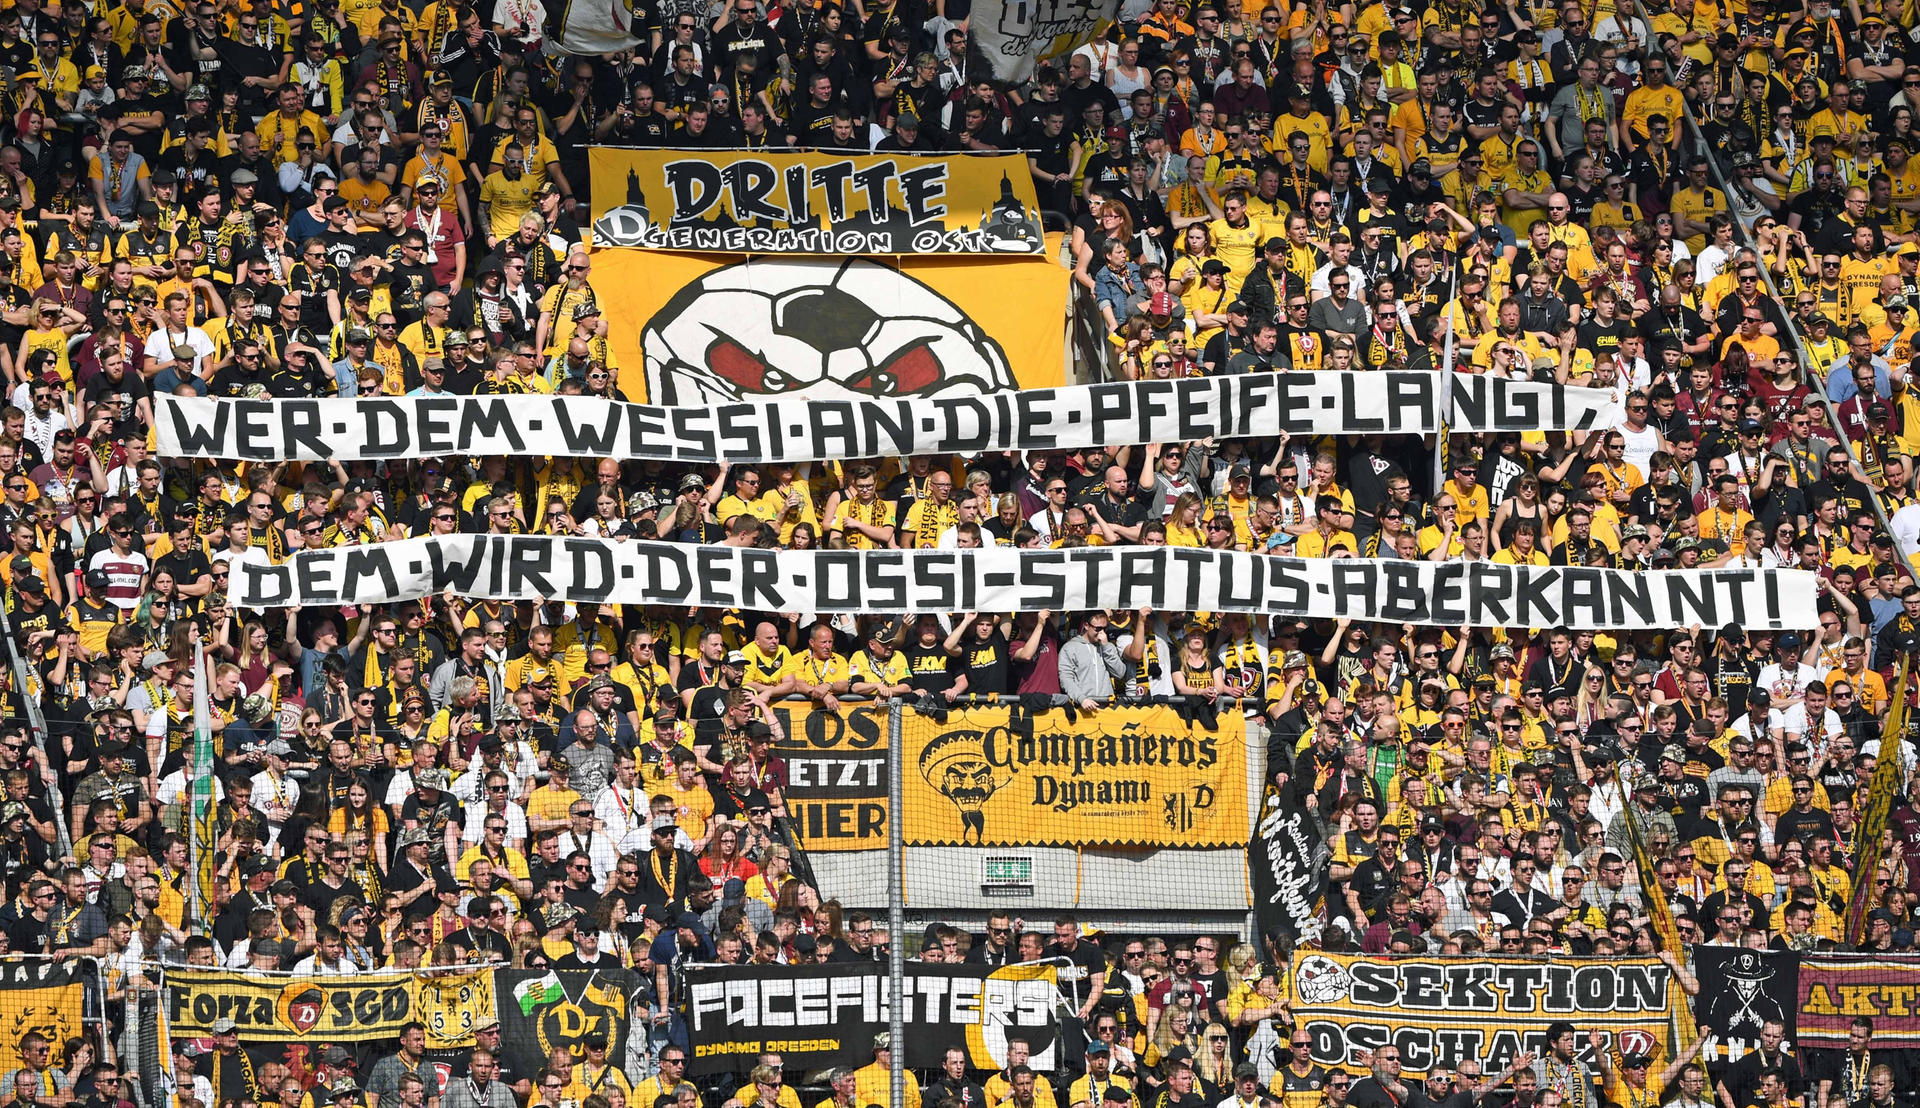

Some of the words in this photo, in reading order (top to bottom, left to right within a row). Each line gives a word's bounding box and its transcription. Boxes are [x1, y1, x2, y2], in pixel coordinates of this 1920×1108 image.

[664, 158, 949, 227] DRITTE
[642, 226, 892, 254] GENERATION
[167, 399, 334, 460] WER
[357, 399, 526, 456] DEM
[552, 399, 784, 463] WESSI
[808, 400, 914, 459] AN
[933, 389, 1058, 452] DIE
[1090, 372, 1315, 446] PFEIFE
[241, 547, 399, 605] DEM
[426, 535, 615, 601] WIRD
[638, 542, 786, 609] DER
[815, 548, 1309, 615] OSSI-STATUS
[1332, 558, 1783, 629] ABERKANNT!
[773, 706, 880, 748] LOS
[983, 722, 1218, 776] Compañeros
[782, 757, 885, 788] ETZT
[1032, 774, 1151, 813] Dynamo
[170, 985, 274, 1026] Forza
[330, 984, 410, 1027] SGD
[691, 974, 1057, 1032] FACEFISTERS
[1349, 962, 1670, 1014] SEKTION
[695, 1040, 761, 1057] DYNAMO
[766, 1038, 841, 1053] DRESDEN
